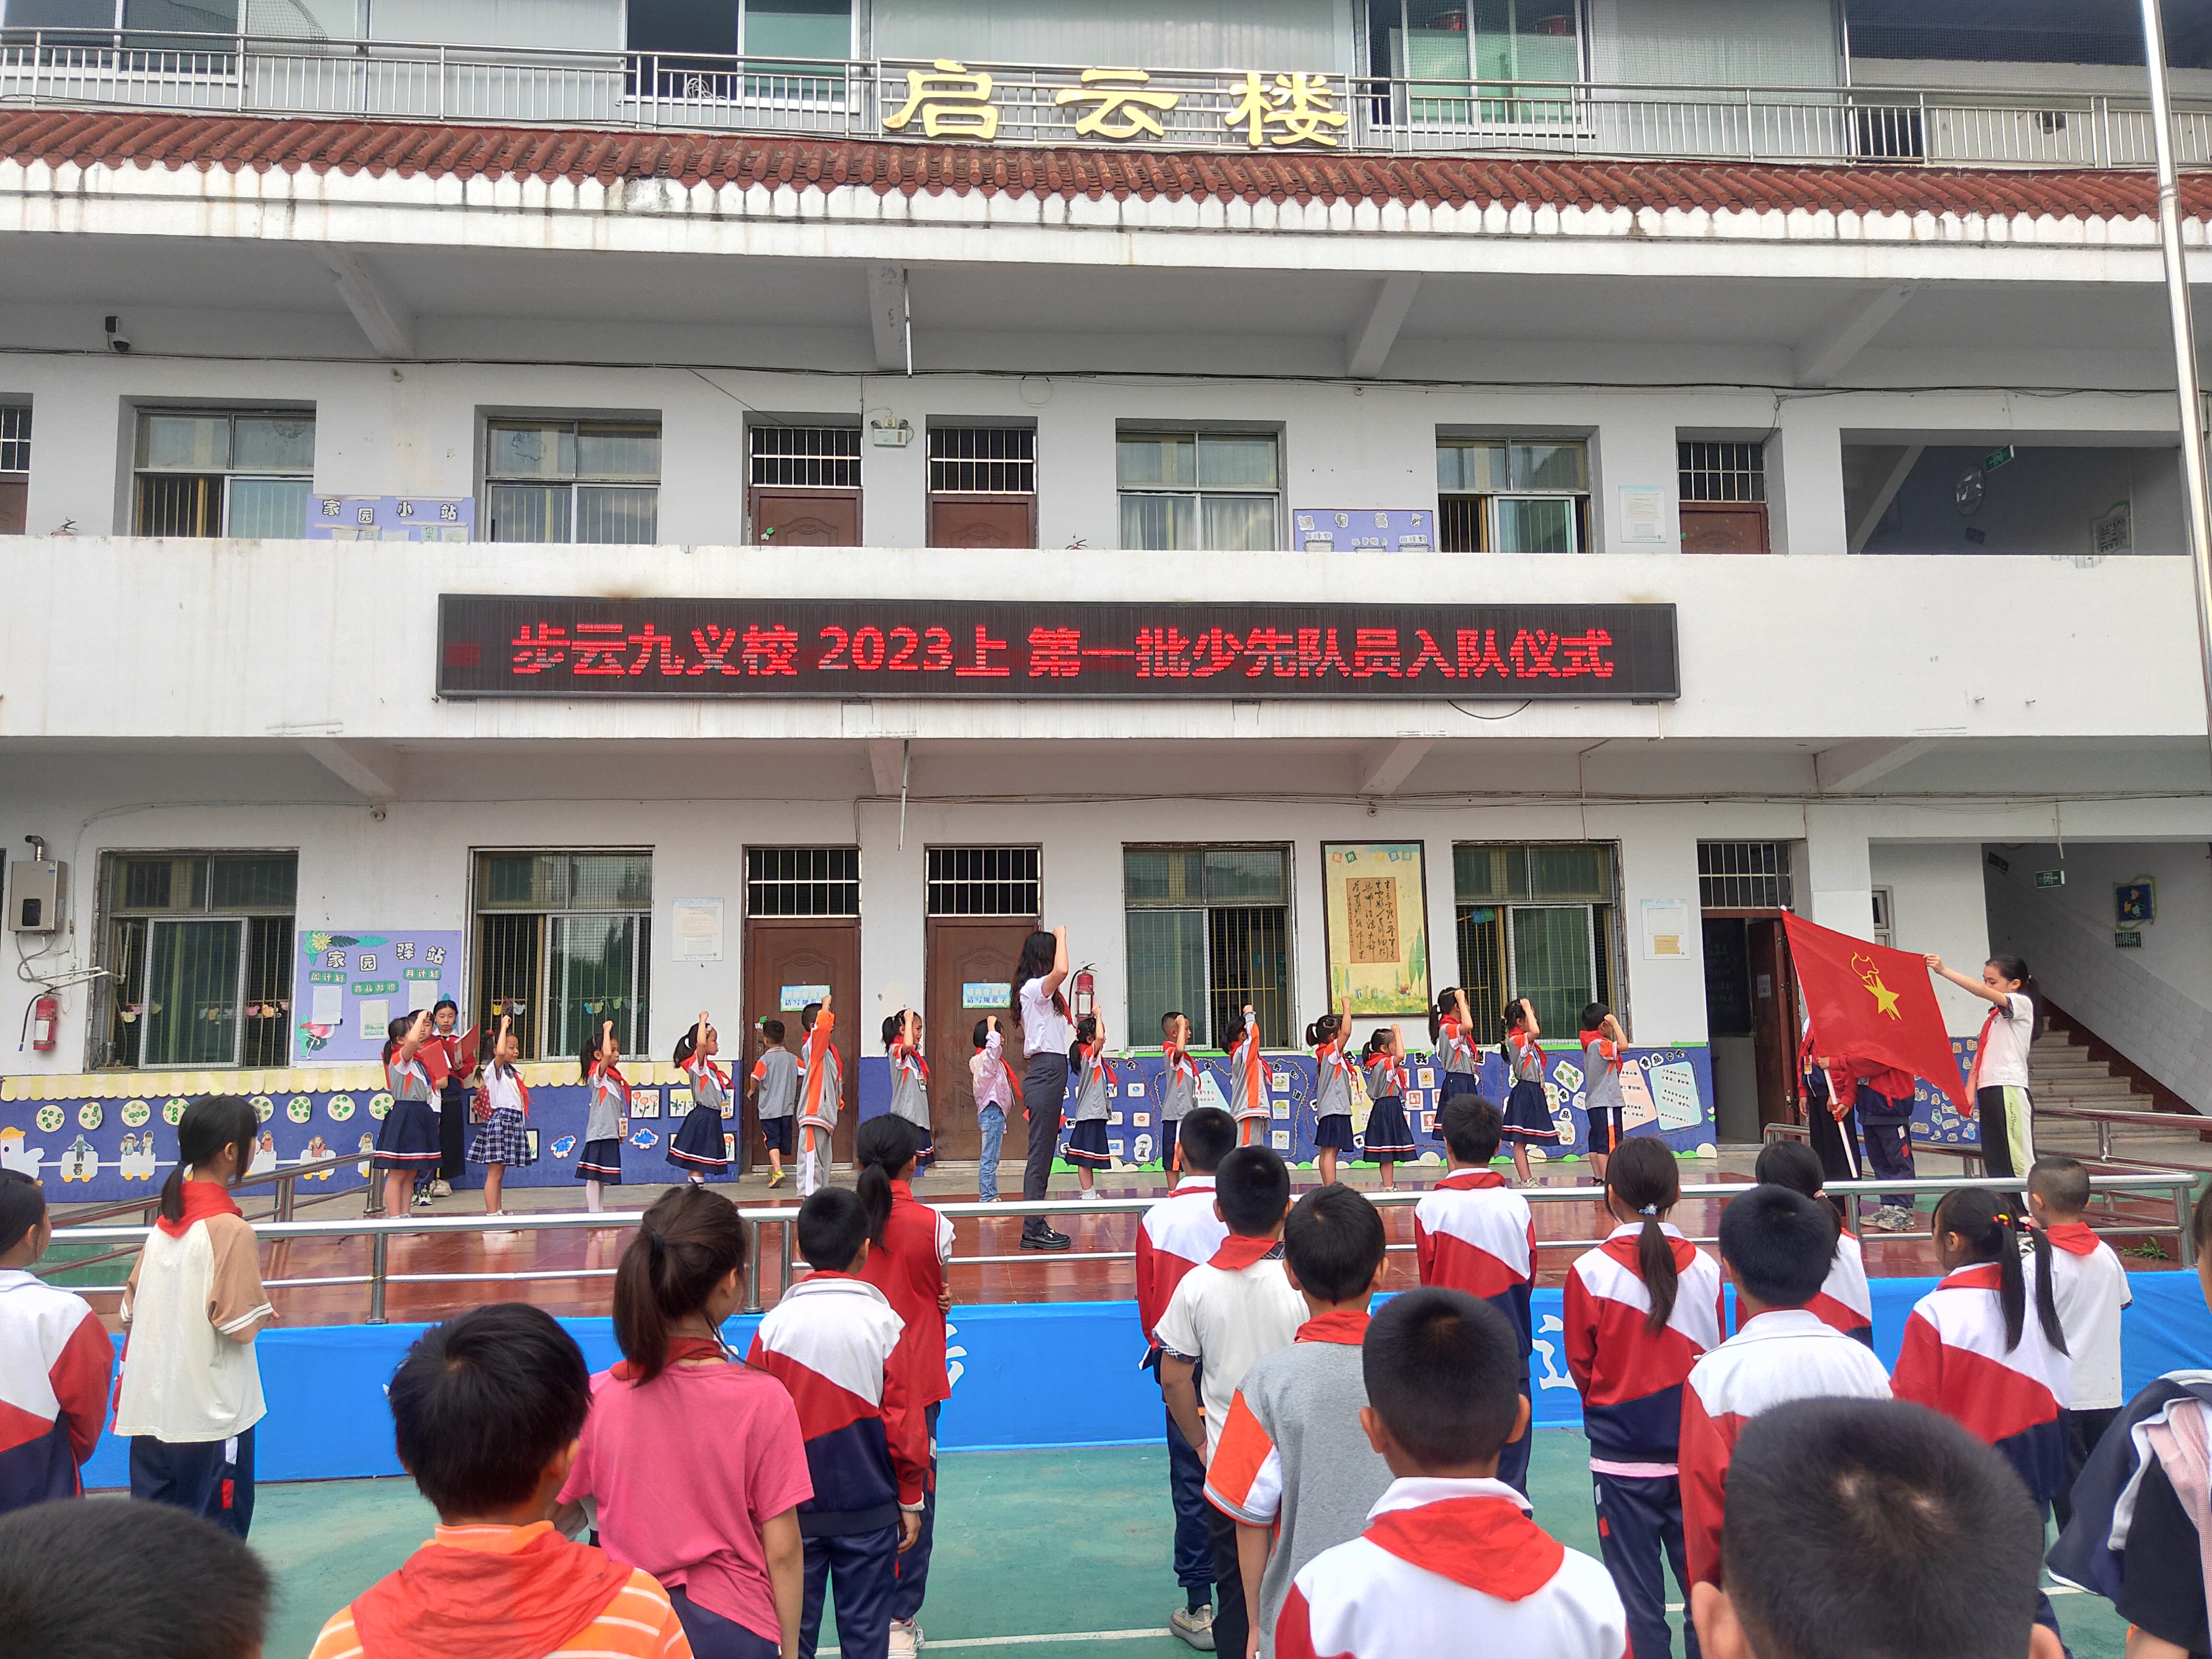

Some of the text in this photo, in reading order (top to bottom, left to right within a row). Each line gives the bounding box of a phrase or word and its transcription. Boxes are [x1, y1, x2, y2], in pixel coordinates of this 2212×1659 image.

[887, 60, 1345, 144] 启云楼
[322, 499, 457, 524] 家园小站
[512, 624, 1613, 677] 步云九义校 2023上 第一批少先队员入队仪式
[327, 942, 445, 971] 家园驿站
[311, 973, 345, 982] 周计划
[406, 969, 439, 978] 月计划
[354, 983, 396, 993] 育儿知识
